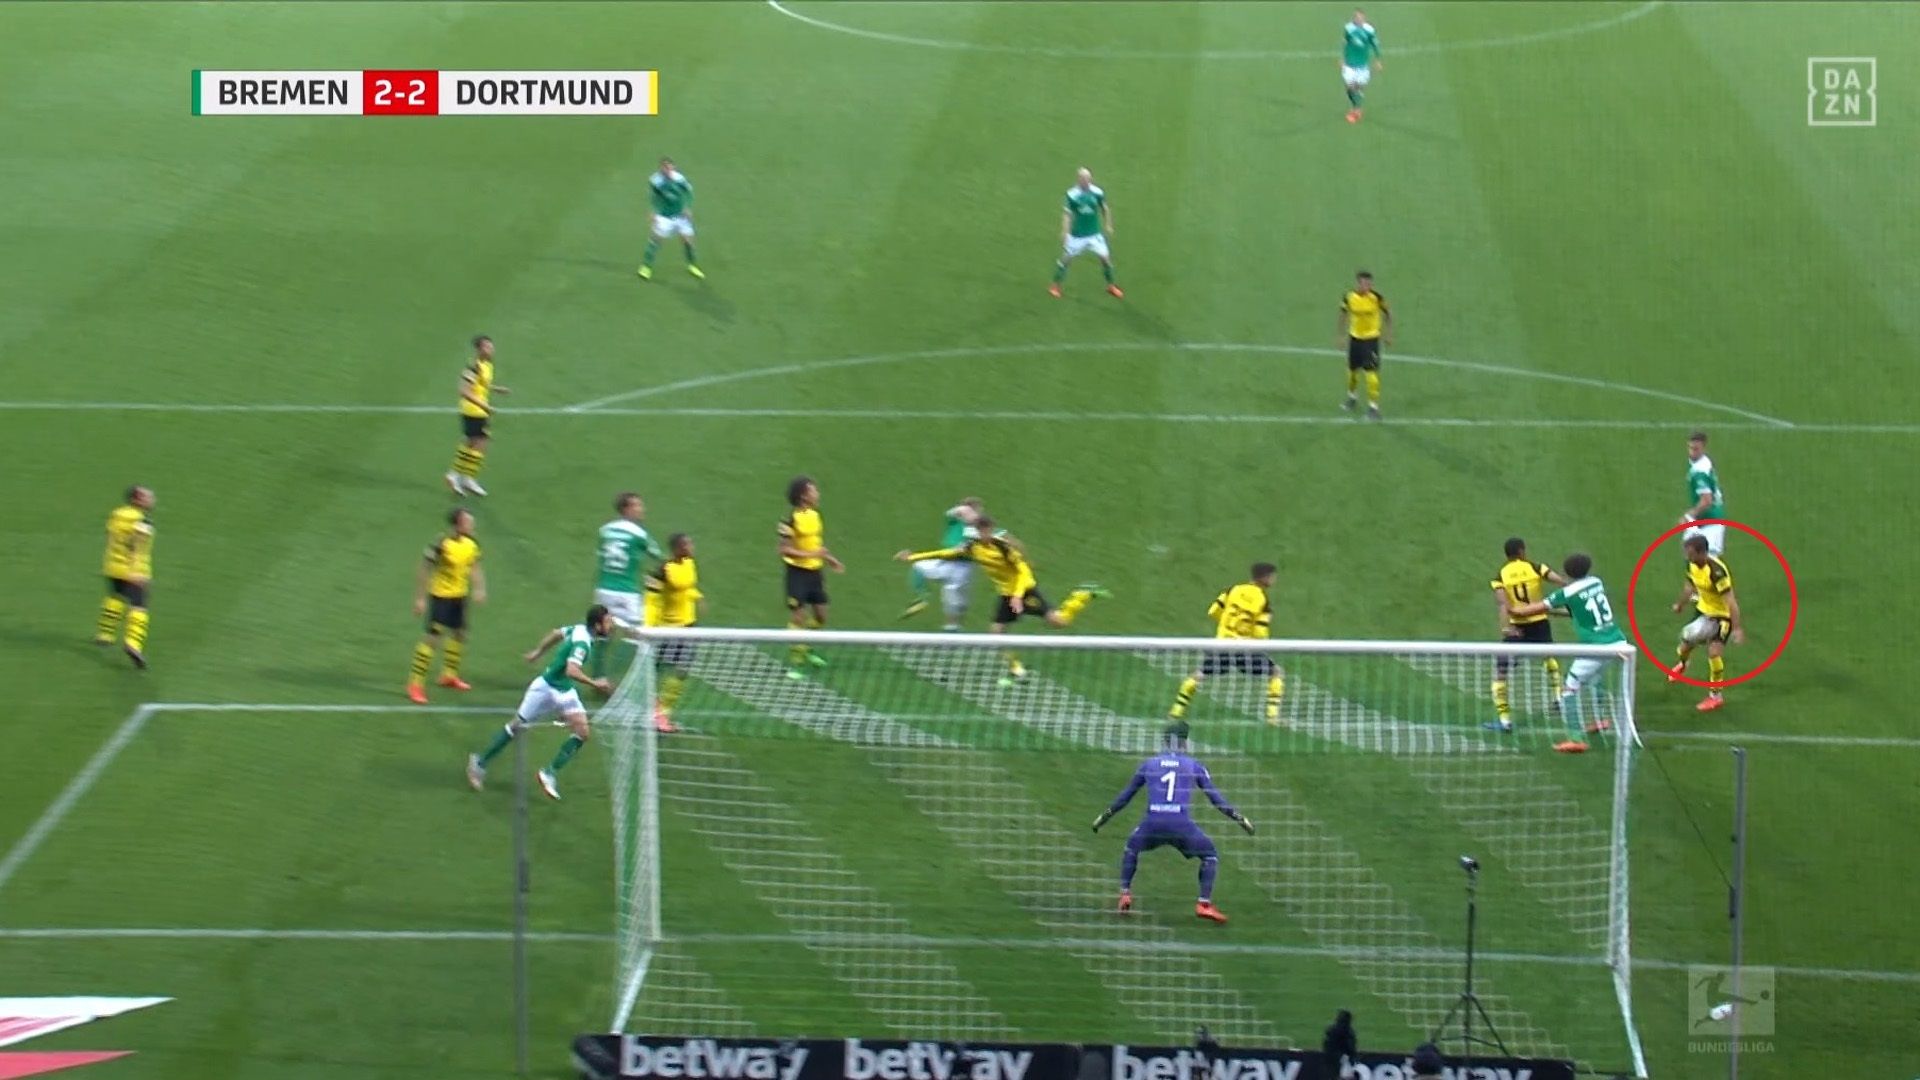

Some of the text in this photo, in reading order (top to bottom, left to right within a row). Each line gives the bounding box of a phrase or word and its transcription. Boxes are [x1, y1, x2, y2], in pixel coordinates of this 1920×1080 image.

[1513, 582, 1530, 604] 4
[1584, 592, 1613, 627] 13
[1160, 770, 1176, 802] 1
